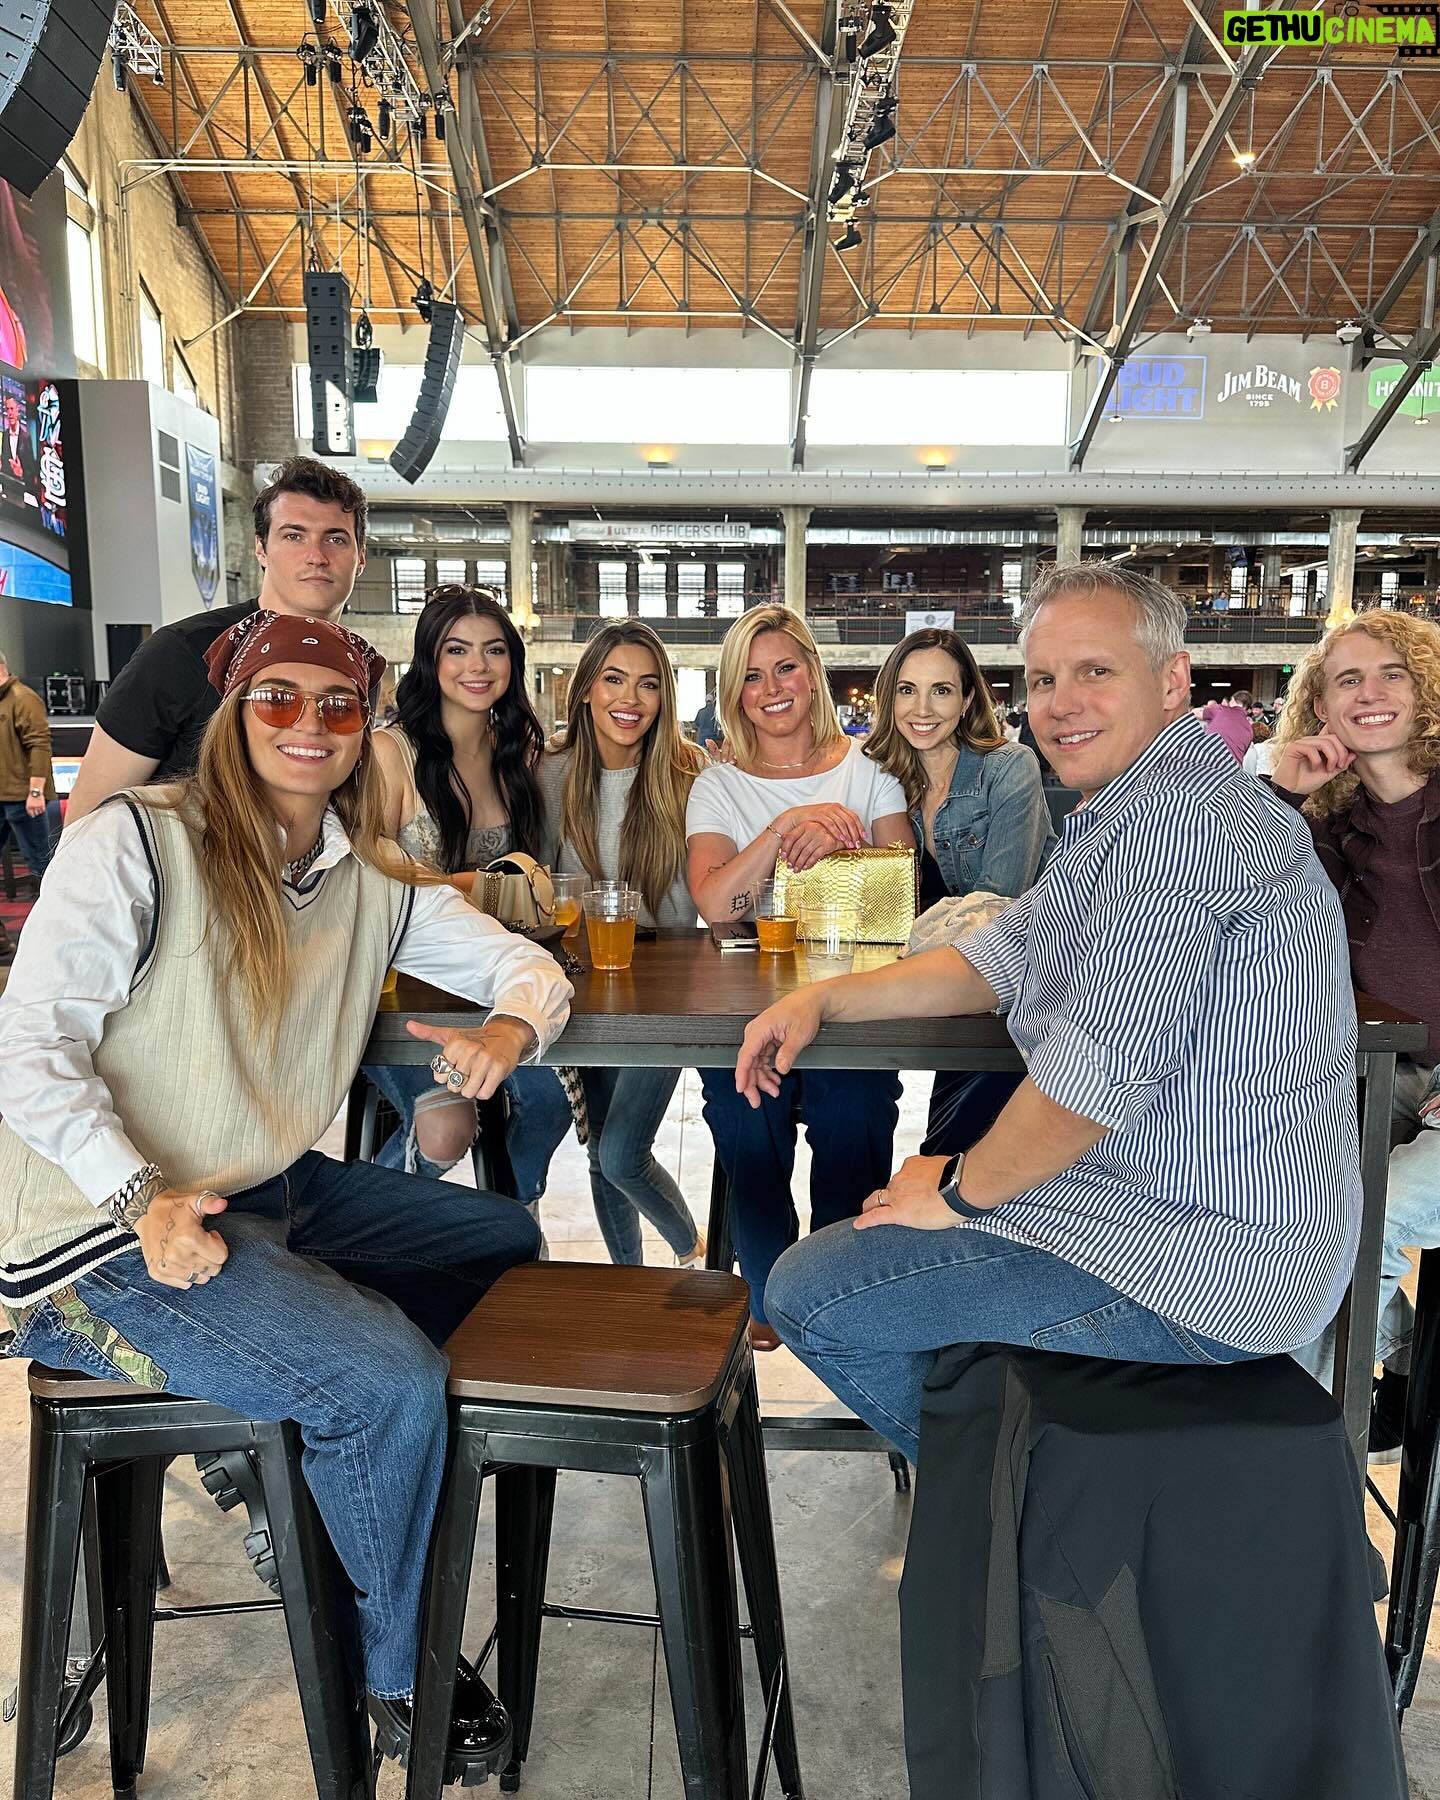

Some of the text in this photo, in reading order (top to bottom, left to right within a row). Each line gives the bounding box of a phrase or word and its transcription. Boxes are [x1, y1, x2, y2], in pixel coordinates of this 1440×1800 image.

[1118, 362, 1184, 386] BUD
[1217, 371, 1252, 402] JIM
[1254, 365, 1302, 403] BEAM
[1104, 386, 1197, 412] LIGHT
[1246, 393, 1274, 401] SINCE
[1375, 381, 1440, 398] HNIT
[614, 527, 646, 536] ULTRA
[651, 524, 711, 538] OFFICER'S
[714, 525, 746, 538] CLUB
